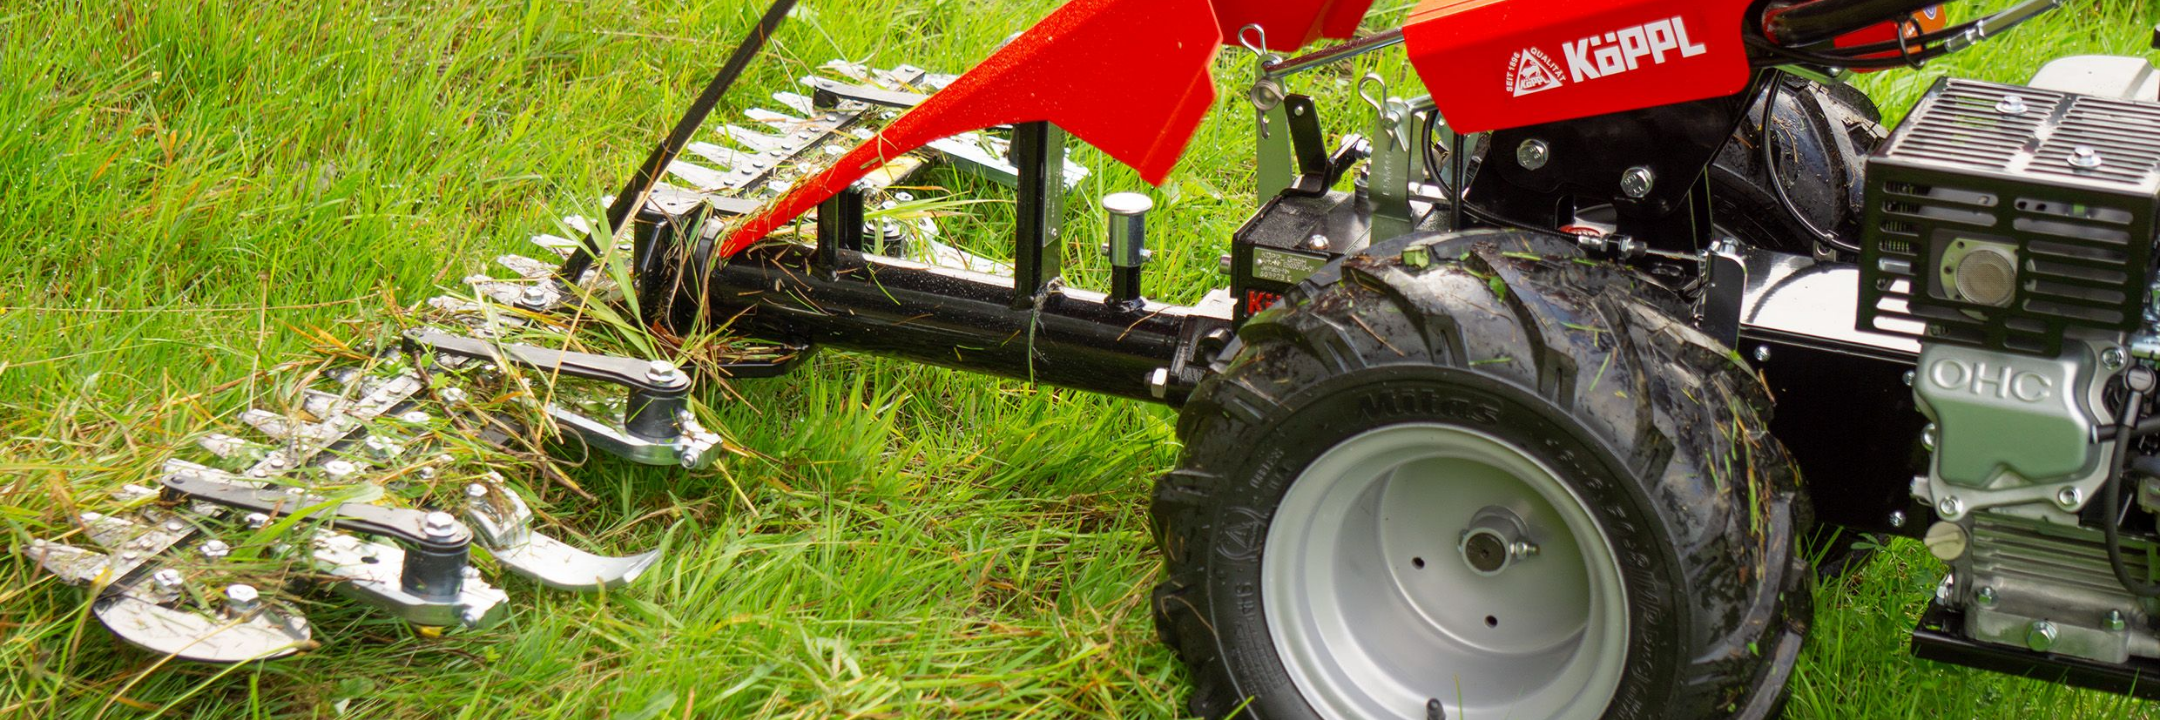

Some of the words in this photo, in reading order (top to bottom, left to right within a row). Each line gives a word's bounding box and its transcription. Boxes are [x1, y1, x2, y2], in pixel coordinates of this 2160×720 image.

[1508, 51, 1520, 71] 1896
[1530, 46, 1566, 82] QUALITÄT
[1562, 15, 1706, 83] KÖPPL
[1505, 71, 1514, 92] SEIT
[1930, 358, 2052, 402] OHC
